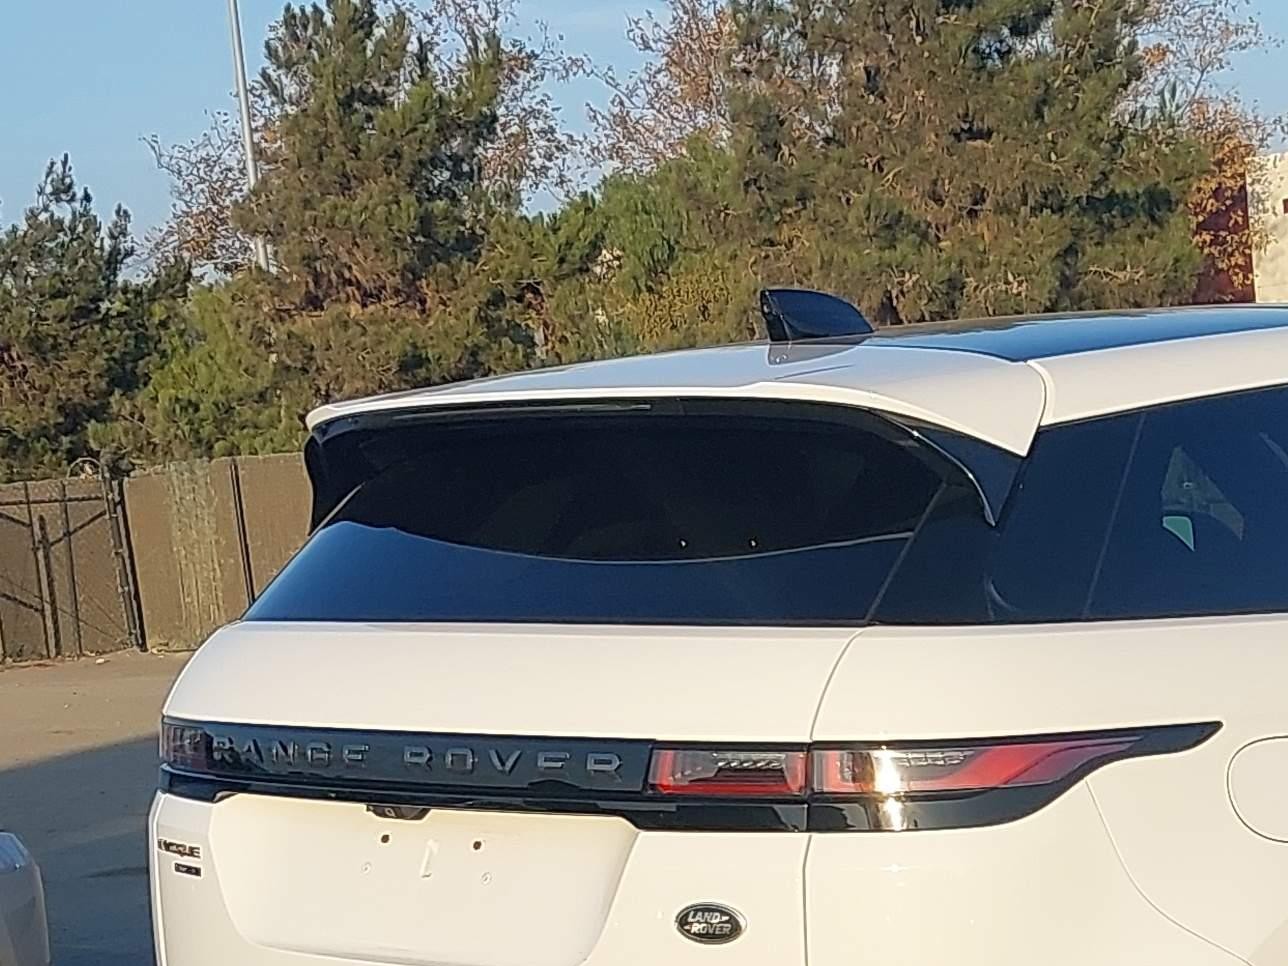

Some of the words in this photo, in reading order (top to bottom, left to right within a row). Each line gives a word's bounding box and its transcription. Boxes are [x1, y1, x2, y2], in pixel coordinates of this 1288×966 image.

[211, 736, 370, 768] RANGE
[403, 744, 625, 776] ROVER
[687, 910, 721, 924] LAND
[690, 922, 732, 935] ROVER
